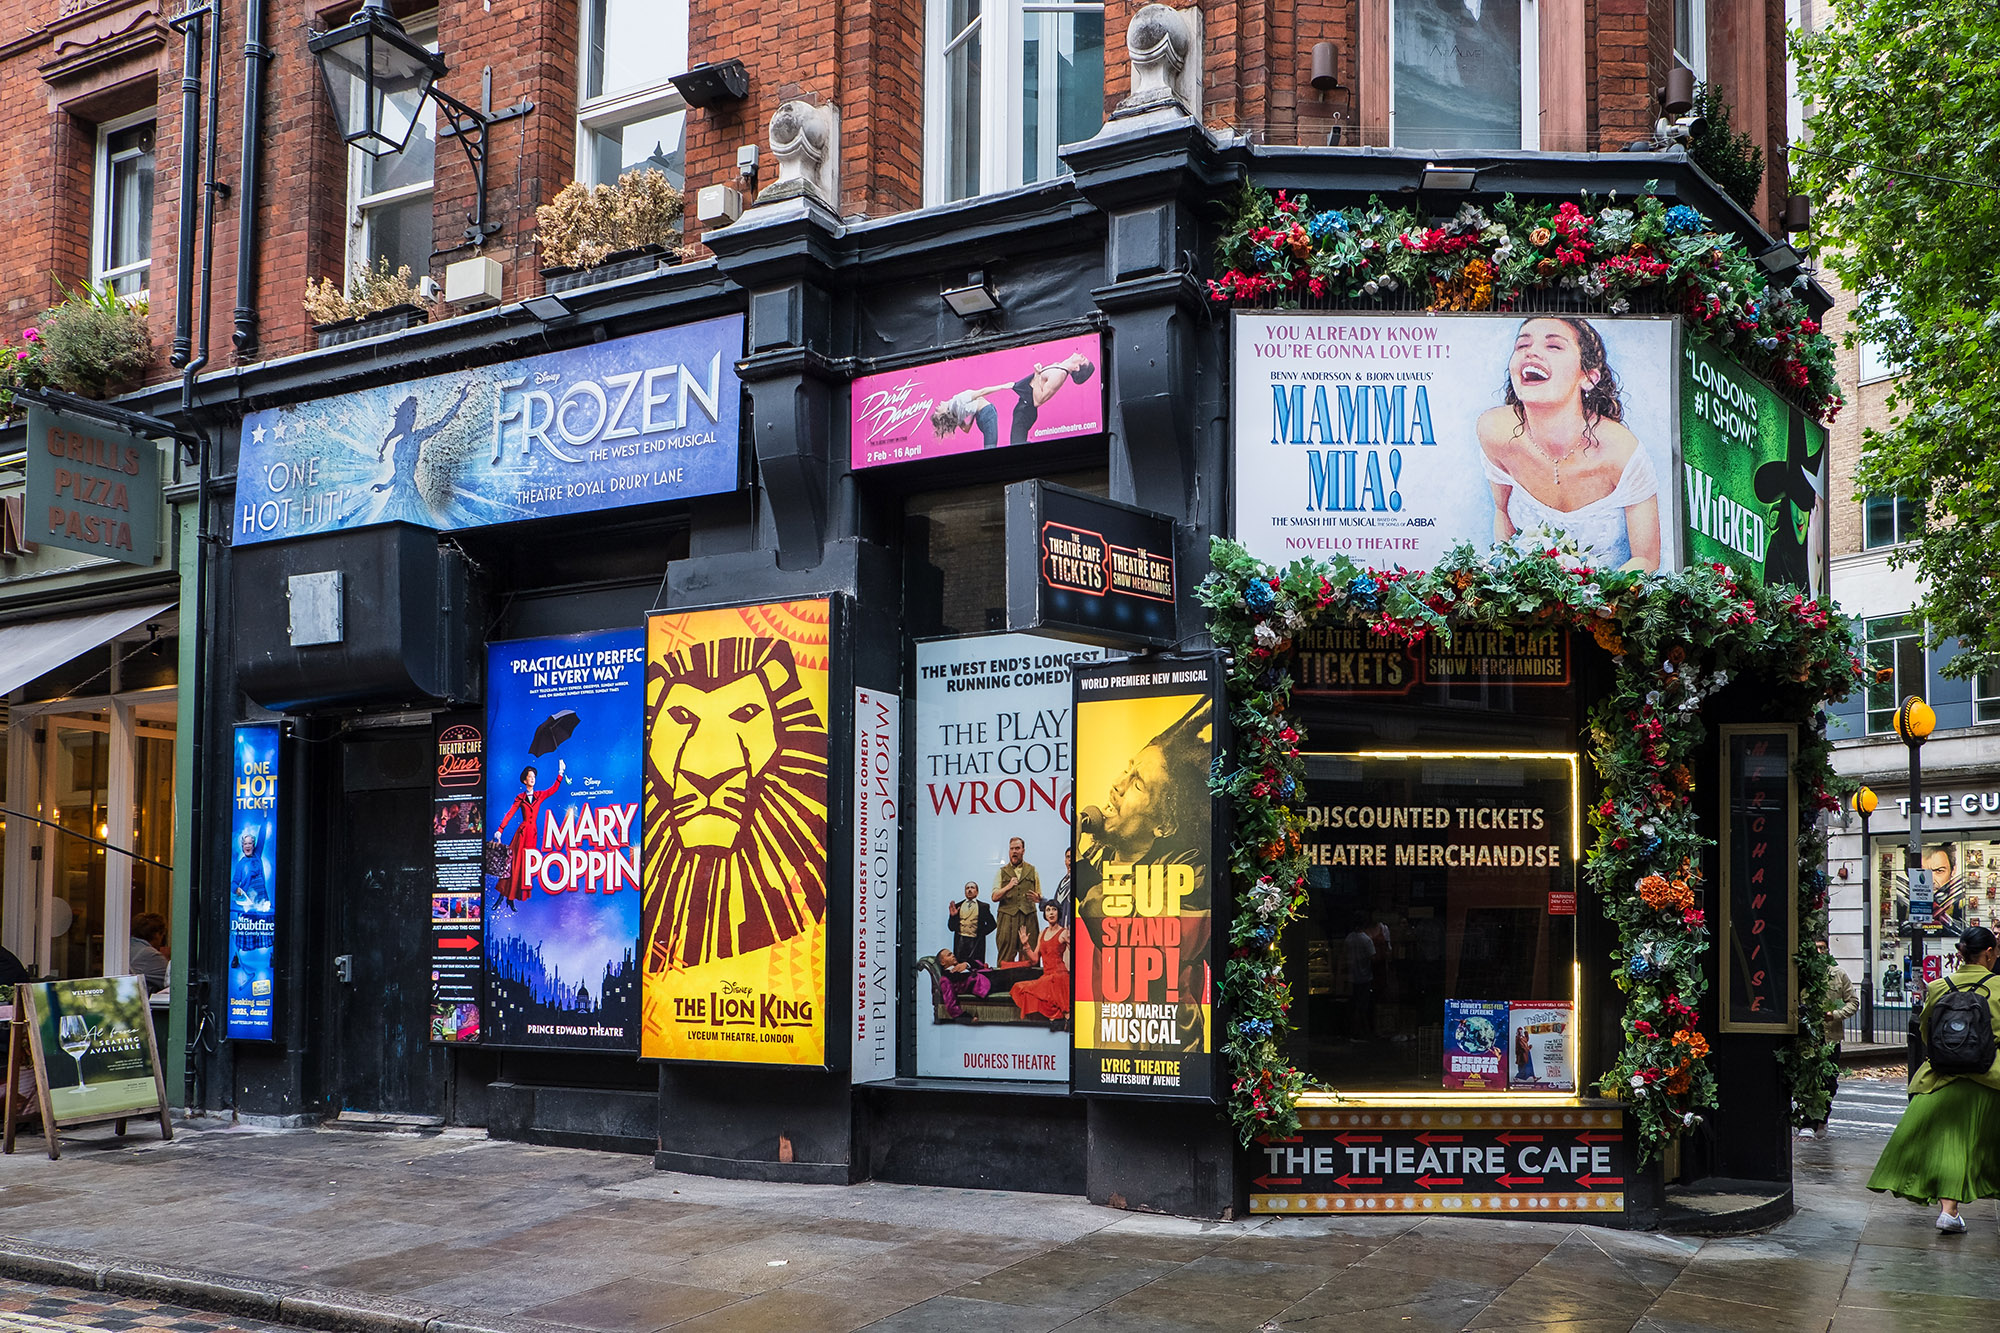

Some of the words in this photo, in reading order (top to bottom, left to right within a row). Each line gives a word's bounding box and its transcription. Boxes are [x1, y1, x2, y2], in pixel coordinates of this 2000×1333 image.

[1266, 325, 1300, 341] YOU
[1305, 326, 1382, 341] ALREADY
[1387, 327, 1439, 341] KNOW
[1253, 343, 1313, 359] YOU'RE
[1316, 344, 1376, 359] GONNA
[1380, 344, 1422, 359] LOVE
[1426, 344, 1451, 359] IT!
[533, 371, 561, 385] Disney
[1270, 371, 1298, 381] BENNY
[1300, 371, 1352, 382] ANDERSSON
[1355, 371, 1363, 381] &
[1366, 371, 1395, 382] BJORN
[491, 350, 722, 465] FROZEN
[856, 378, 925, 422] Dirty
[1694, 391, 1709, 420] #1
[867, 393, 934, 441] Dancing
[1271, 384, 1437, 446] MAMMA
[1034, 421, 1097, 438] dominiontheatre.com
[47, 426, 140, 476] GRILLS
[589, 449, 609, 462] THE
[611, 445, 641, 459] WEST
[643, 441, 666, 453] END
[668, 432, 717, 450] MUSICAL
[867, 452, 873, 462] 2
[873, 450, 887, 461] Feb
[893, 447, 903, 458] 16
[904, 444, 922, 457] April
[55, 467, 129, 512] PIZZA
[516, 488, 563, 505] THEATRE
[567, 480, 606, 497] ROYAL
[610, 473, 650, 492] DRURY
[653, 467, 684, 484] LANE
[1306, 448, 1403, 512] MIA!
[49, 506, 132, 551] PASTA
[243, 498, 293, 534] HOT
[1271, 517, 1289, 527] THE
[1290, 517, 1321, 527] SMASH
[1322, 517, 1337, 527] HIT
[1339, 517, 1376, 527] MUSICAL
[1049, 537, 1081, 559] THEATRE
[1082, 545, 1101, 564] CAFE
[1071, 532, 1080, 544] THE
[1285, 537, 1353, 550] NOVELLO
[1355, 538, 1419, 551] THEATRE
[1137, 547, 1147, 560] THE
[1050, 555, 1102, 588] TICKETS
[1112, 553, 1149, 578] THEATRE
[1150, 561, 1170, 583] CAFE
[1113, 574, 1131, 589] SHOW
[1131, 577, 1172, 597] MERCHANDISE
[1514, 630, 1559, 656] CAFE
[596, 647, 645, 666] PERFEC
[921, 665, 947, 679] THE
[950, 661, 986, 676] WEST
[990, 657, 1031, 673] END'S
[1034, 651, 1100, 669] LONGEST
[1299, 652, 1403, 685] TICKETS
[1429, 658, 1467, 676] SHOW
[1471, 657, 1562, 676] MERCHANDISE
[533, 672, 548, 687] IN
[551, 668, 590, 686] EVERY
[947, 675, 1010, 692] RUNNING
[1014, 670, 1072, 687] COMEDY
[1081, 677, 1109, 690] WORLD
[1110, 674, 1151, 688] PREMIERE
[1152, 673, 1170, 684] NEW
[1171, 669, 1208, 683] MUSICAL
[939, 722, 988, 746] THE
[996, 708, 1070, 742] PLAY
[439, 742, 465, 755] THEATRE
[466, 741, 482, 753] CAFE
[859, 730, 869, 788] COMEDY
[244, 762, 270, 775] ONE
[438, 754, 482, 776] Diner
[927, 751, 994, 776] THAT
[236, 775, 277, 797] HOT
[583, 776, 601, 787] Disney
[236, 797, 276, 810] TICKET
[1895, 795, 1950, 817] THE
[1960, 792, 2000, 813] CU
[543, 803, 638, 849] MARY
[859, 791, 868, 856] RUNNING
[1307, 806, 1450, 829] DISCOUNTED
[1456, 807, 1545, 829] TICKETS
[873, 827, 889, 900] GOES
[1302, 844, 1387, 866] HEATRE
[1395, 845, 1560, 867] MERCHANDISE
[1101, 860, 1133, 917] GET
[1135, 864, 1195, 917] UP
[1751, 741, 1768, 1013] MERCHANDISE
[859, 861, 868, 923] LONGEST
[231, 918, 274, 931] Doubtfire
[875, 905, 887, 958] THAT
[1101, 917, 1181, 947] STAND
[859, 928, 867, 968] END'S
[720, 980, 753, 995] Disney
[1101, 947, 1181, 1003] UP!
[858, 973, 867, 1010] WEST
[872, 960, 887, 1021] PLAY
[674, 998, 705, 1016] THE
[710, 992, 755, 1026] LION
[760, 993, 812, 1028] KING
[1101, 1003, 1110, 1018] THE
[1110, 1003, 1133, 1018] BOB
[1135, 1004, 1178, 1019] MARLEY
[528, 1024, 554, 1035] PRINCE
[556, 1025, 588, 1036] EDWARD
[589, 1025, 623, 1037] THEATRE
[688, 1031, 718, 1041] LYCEUM
[720, 1032, 758, 1043] THEATRE,
[760, 1033, 794, 1044] LONDON
[857, 1014, 866, 1041] THE
[1101, 1018, 1181, 1045] MUSICAL
[90, 1043, 141, 1054] AVAILABLE
[99, 1036, 139, 1047] SEATING
[874, 1025, 885, 1066] THE
[964, 1052, 1009, 1070] DUCHESS
[1011, 1054, 1056, 1071] THEATRE
[1101, 1058, 1131, 1073] LYRIC
[1133, 1059, 1180, 1076] THEATRE
[1451, 1056, 1499, 1065] FUERZA
[1451, 1064, 1499, 1074] BRUTA
[1101, 1073, 1150, 1086] SHAFTESBURY
[1152, 1075, 1180, 1087] AVENUE
[1264, 1147, 1334, 1174] THE
[1345, 1147, 1505, 1174] THEATRE
[1517, 1146, 1611, 1174] CAFE
